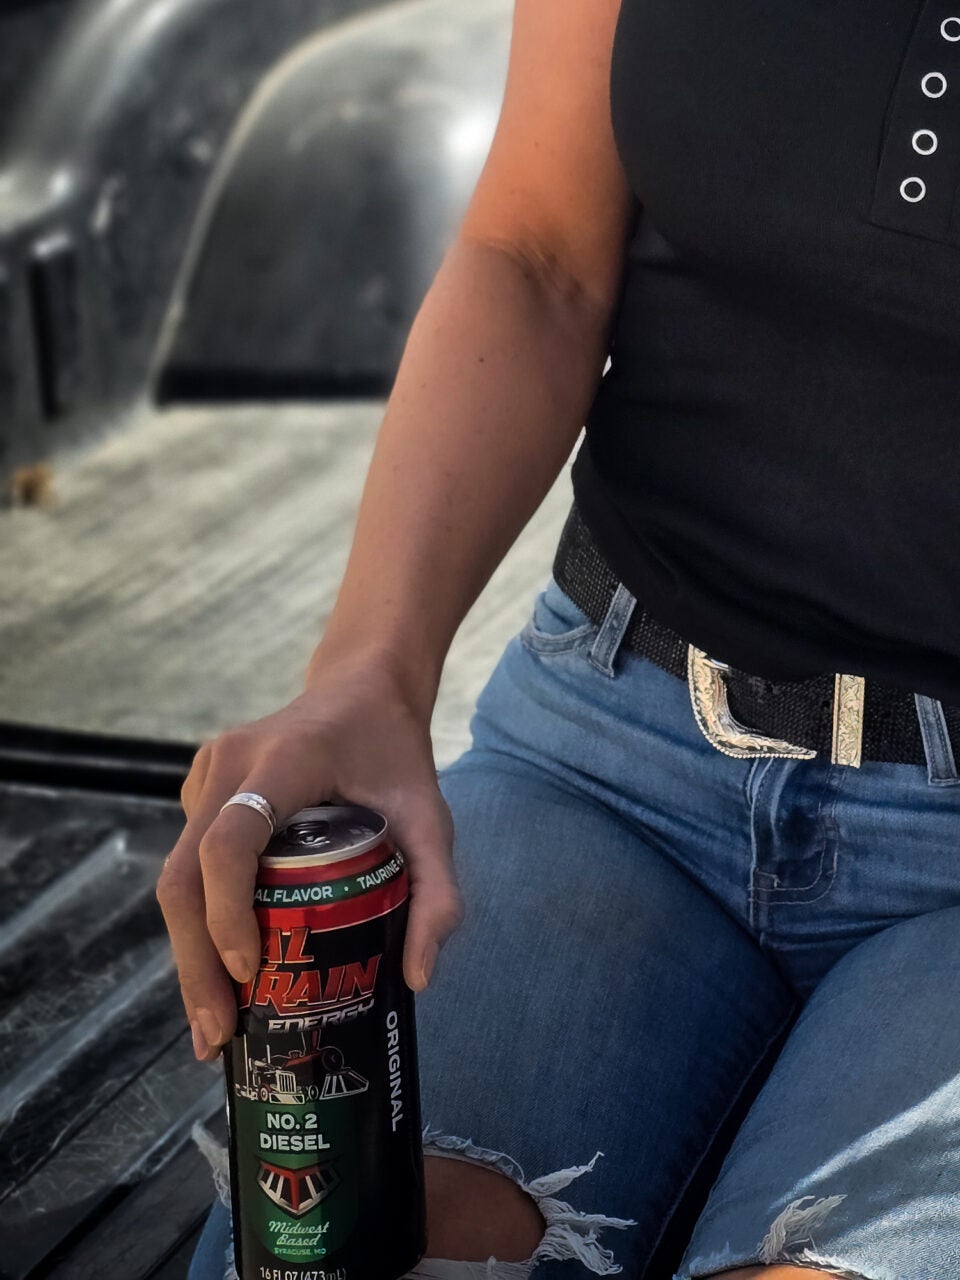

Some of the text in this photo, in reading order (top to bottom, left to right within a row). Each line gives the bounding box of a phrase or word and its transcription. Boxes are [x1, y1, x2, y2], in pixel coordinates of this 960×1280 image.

[273, 885, 334, 903] FLAVOR
[356, 859, 400, 889] TAURINE
[260, 927, 314, 964] AL
[267, 998, 375, 1034] ENERGY
[385, 1010, 404, 1133] ORIGINAL
[266, 1112, 318, 1130] NO. 2
[259, 1132, 331, 1152] DIESEL
[268, 1220, 330, 1234] Midwest
[276, 1233, 322, 1246] Based
[260, 1266, 271, 1280] 16
